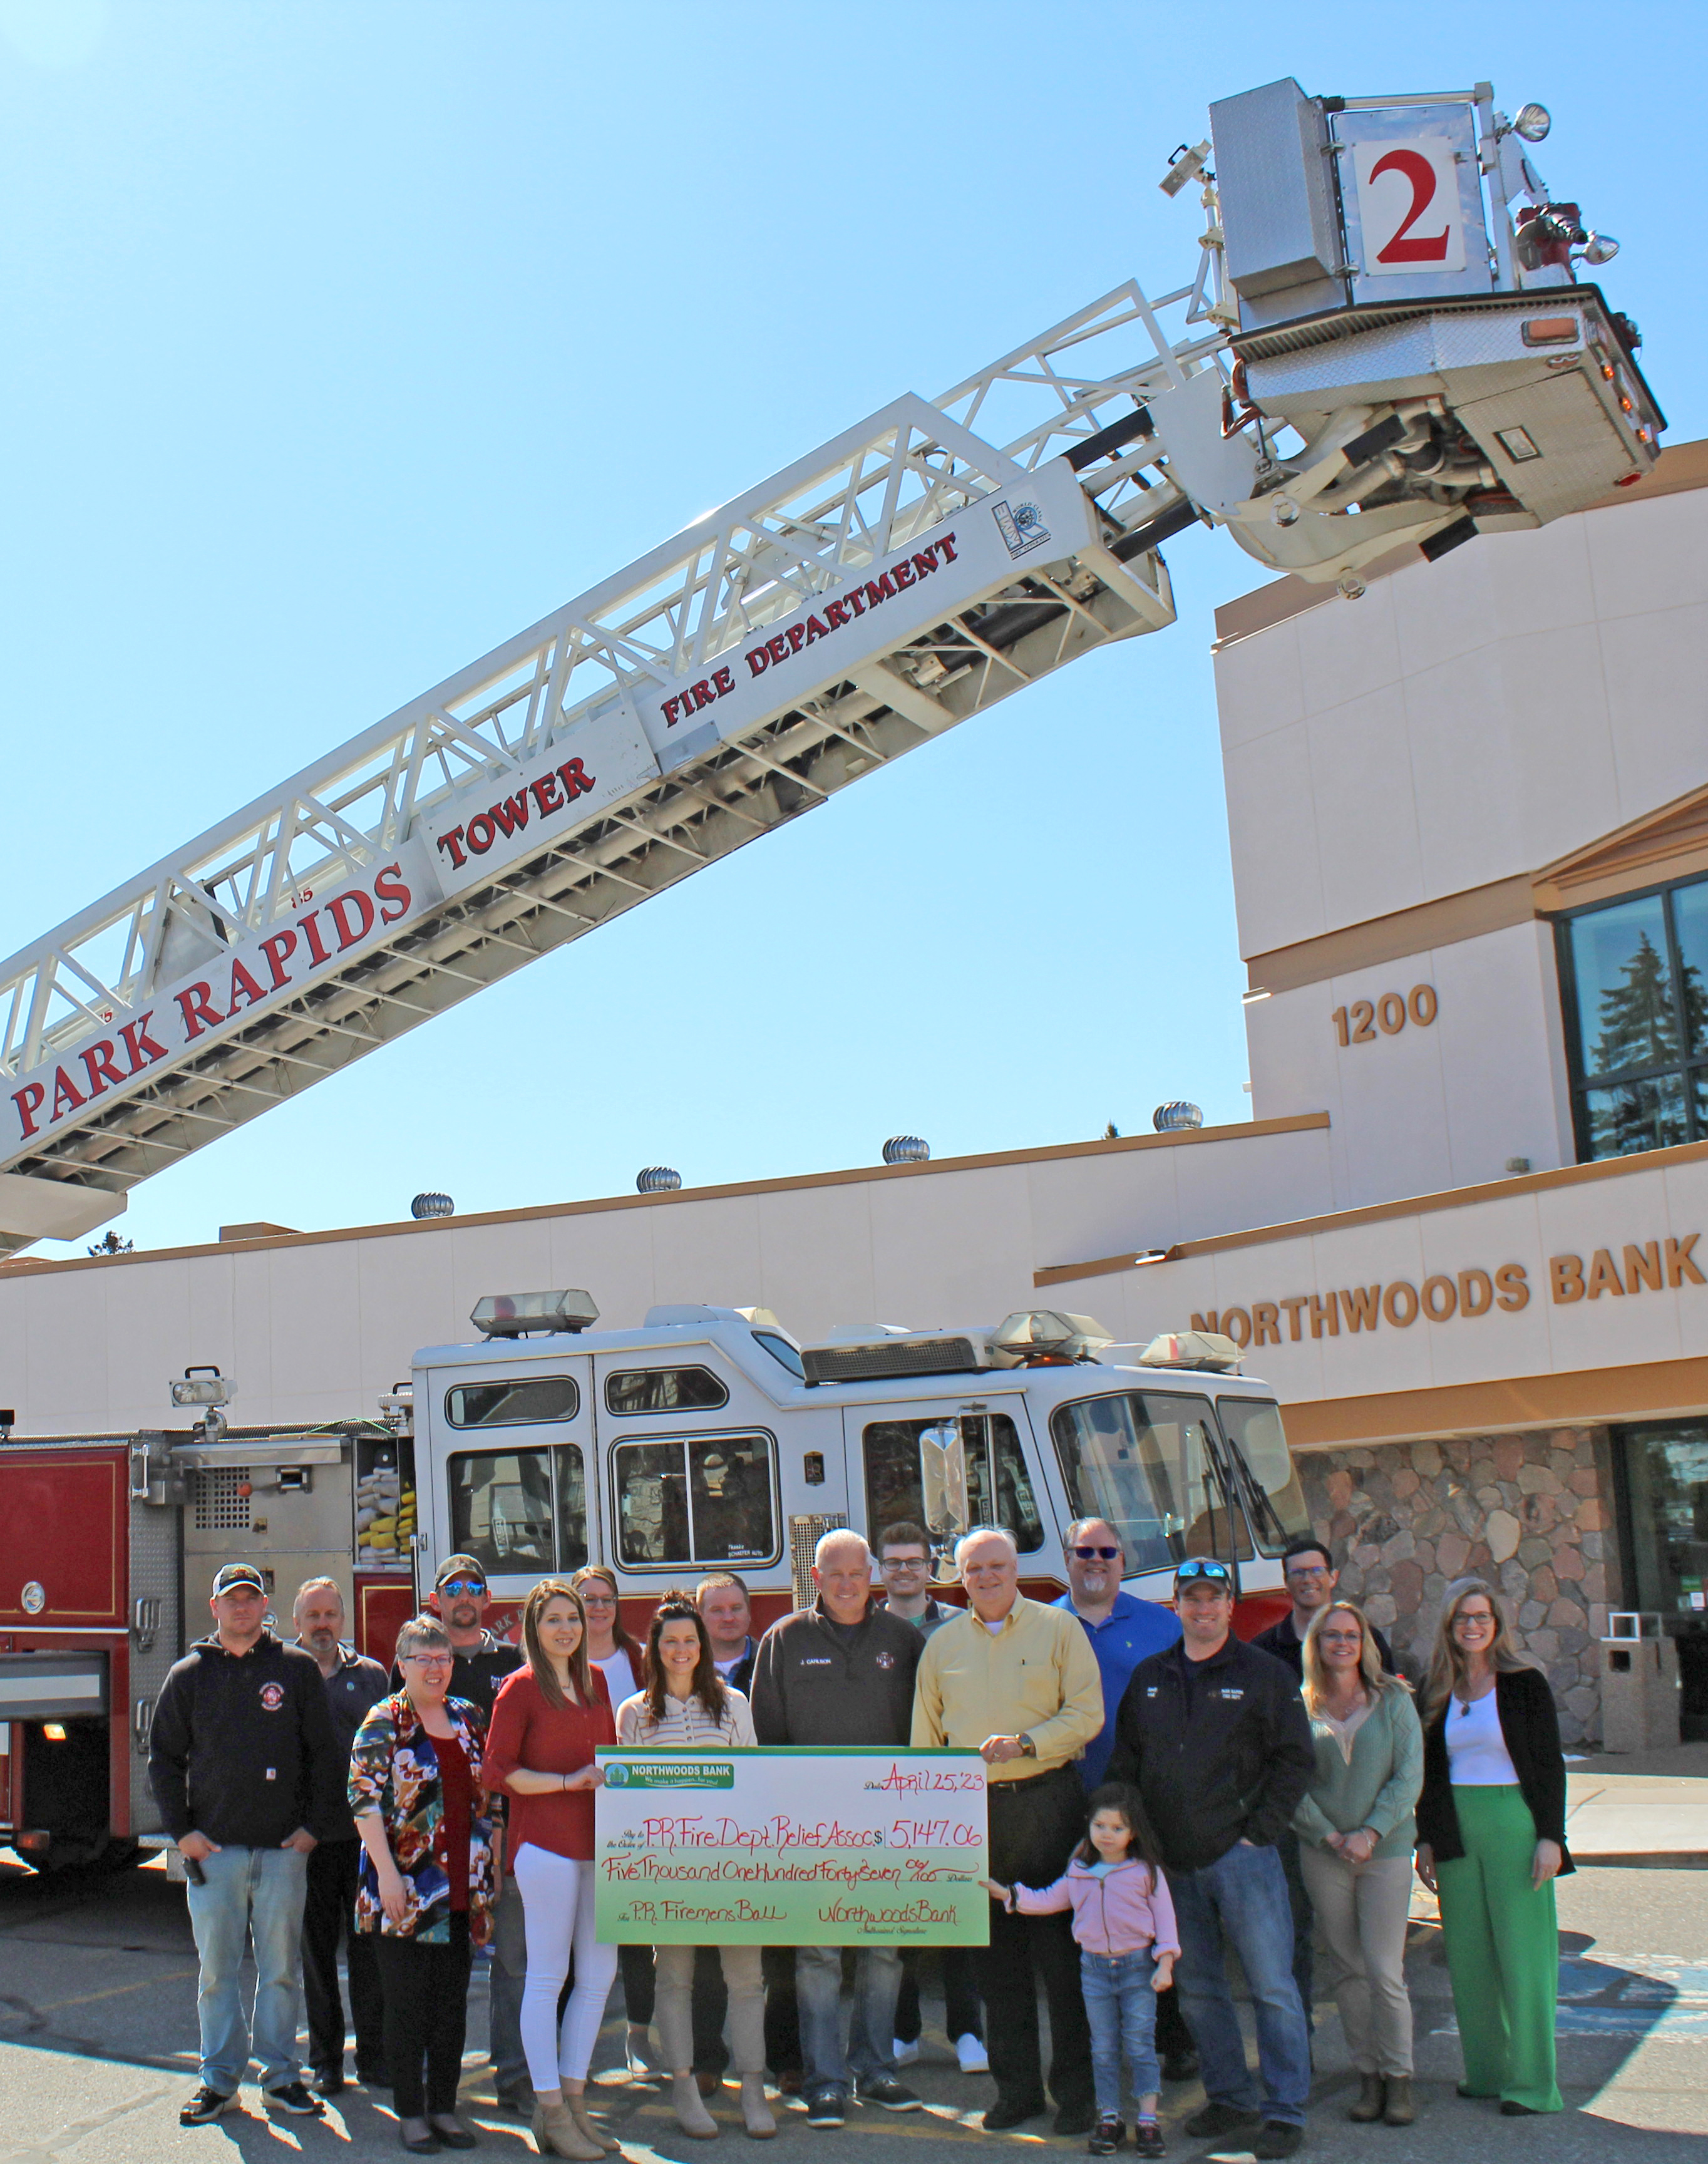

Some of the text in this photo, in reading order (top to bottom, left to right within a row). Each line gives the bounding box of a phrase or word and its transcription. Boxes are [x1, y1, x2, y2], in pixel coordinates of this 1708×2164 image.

[1369, 149, 1450, 263] 2
[661, 532, 958, 728] FIRE DEPARTMENT
[437, 757, 595, 870] TOWER
[11, 862, 411, 1141] PARK RAPIDS
[1331, 984, 1438, 1047] 1200
[1550, 1234, 1707, 1304] BANK
[632, 1765, 730, 1776] NORTHWOODS BANK
[601, 1852, 640, 1882] Five
[634, 1854, 721, 1884] Thousand
[756, 1862, 817, 1883] Hundred
[676, 1815, 719, 1847] Fire
[770, 1815, 826, 1860] Relief
[916, 1899, 959, 1927] Bank
